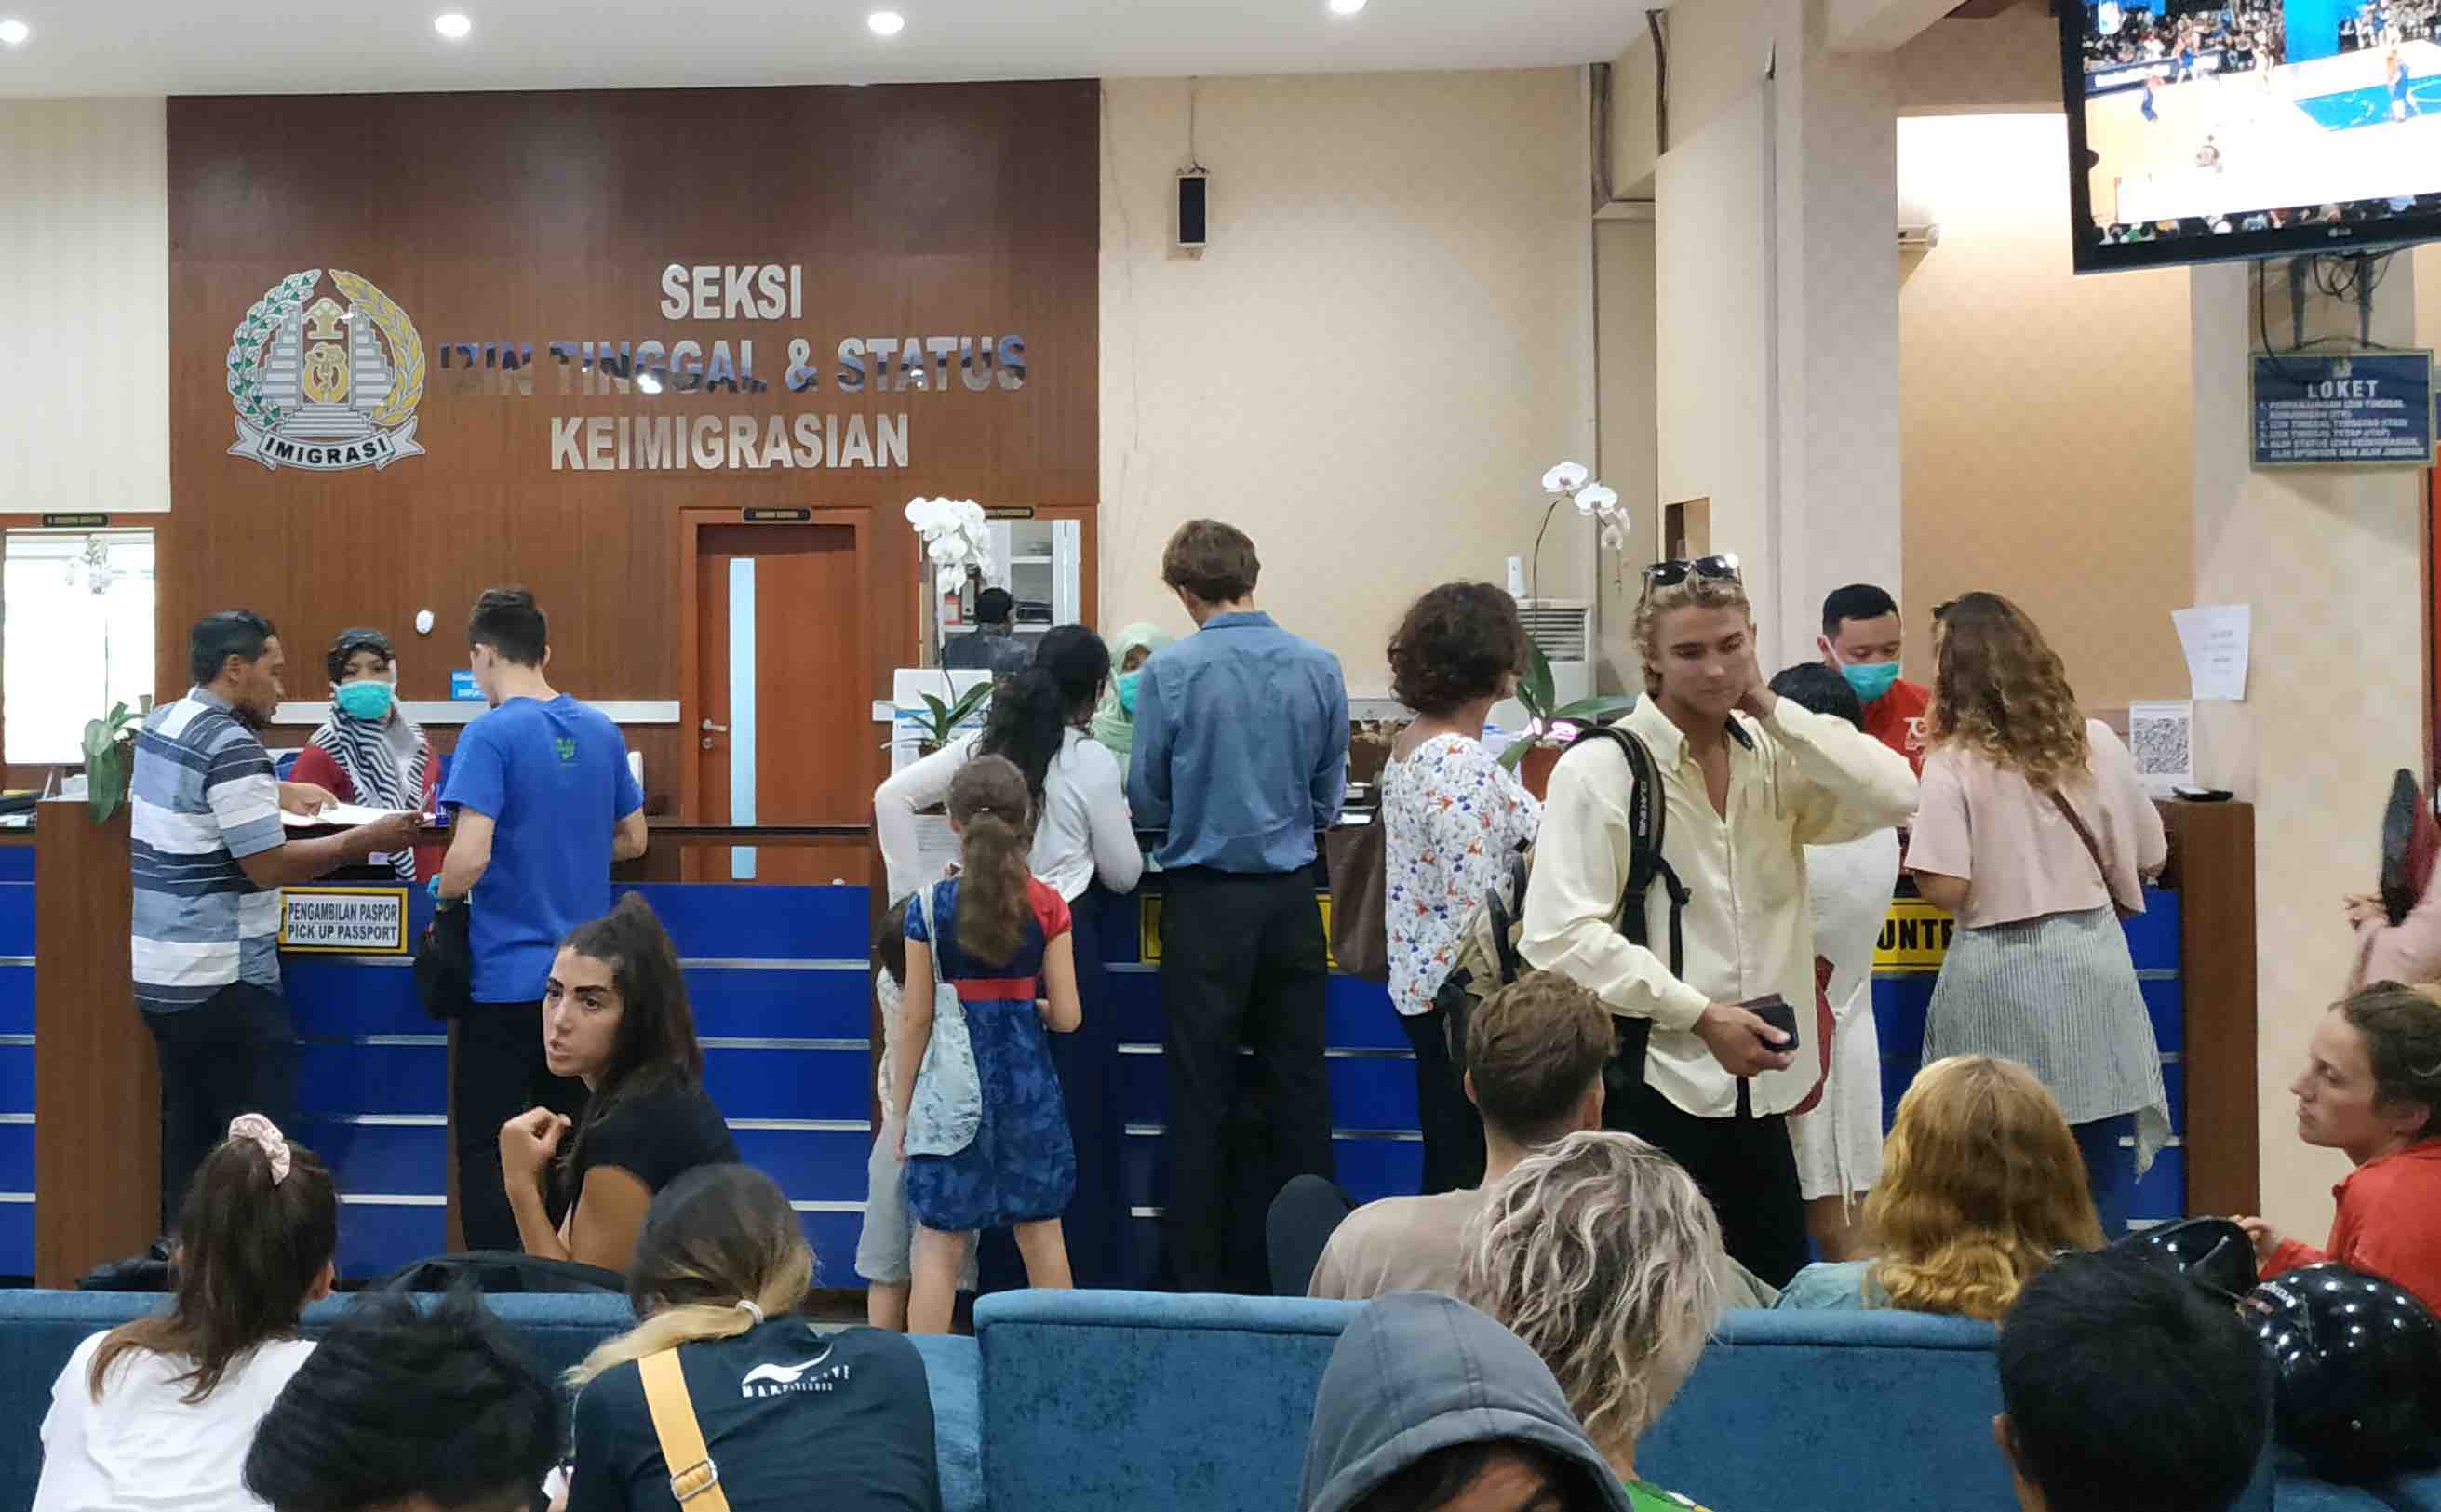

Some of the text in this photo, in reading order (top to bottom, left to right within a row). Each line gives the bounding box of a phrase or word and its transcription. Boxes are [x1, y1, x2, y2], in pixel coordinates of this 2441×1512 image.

[661, 264, 802, 320] SEKSI
[438, 334, 1027, 395] IZIN TINGGAL & STATUS
[2308, 380, 2379, 398] LOKET
[264, 437, 388, 463] IMIGRASI
[550, 413, 909, 469] KEIMIGRASIAN
[288, 902, 397, 922] PENGAMBILAN PASPOR
[288, 924, 397, 941] PICK UP PASSPORT
